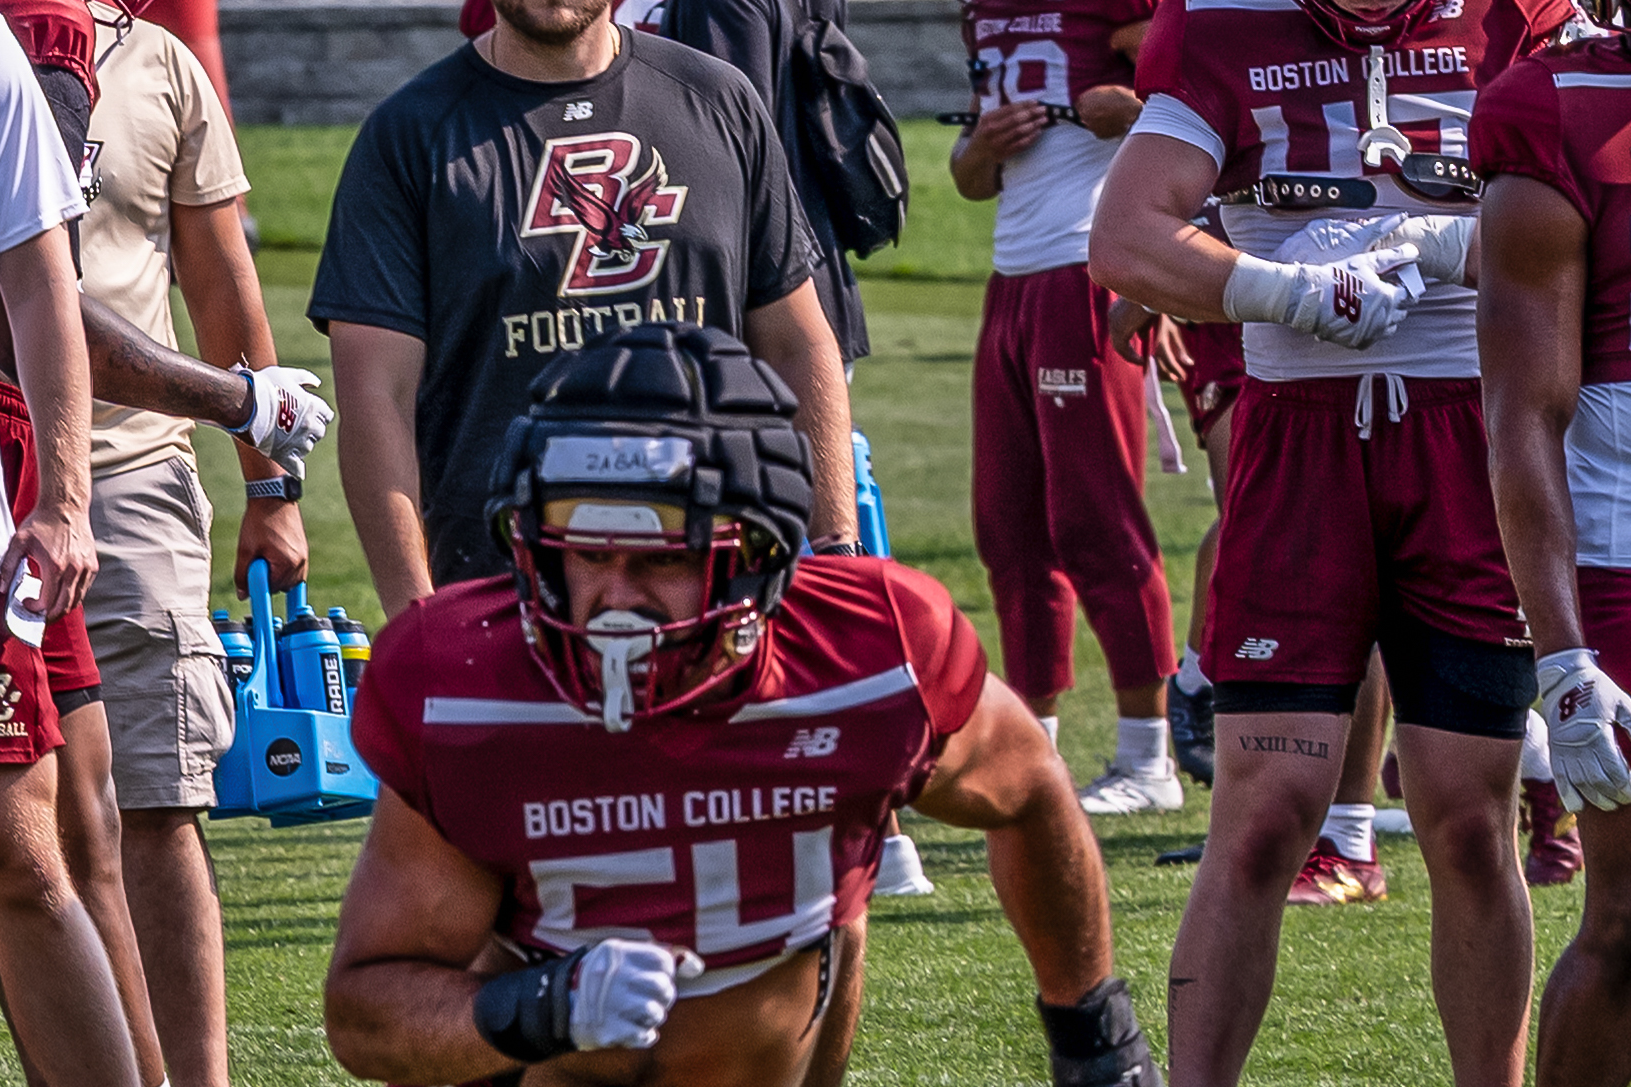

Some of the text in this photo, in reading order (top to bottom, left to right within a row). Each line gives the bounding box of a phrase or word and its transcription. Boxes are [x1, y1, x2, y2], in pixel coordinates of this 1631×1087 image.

[1249, 57, 1350, 92] BOSTON
[523, 786, 838, 840] BOSTON COLLEGE
